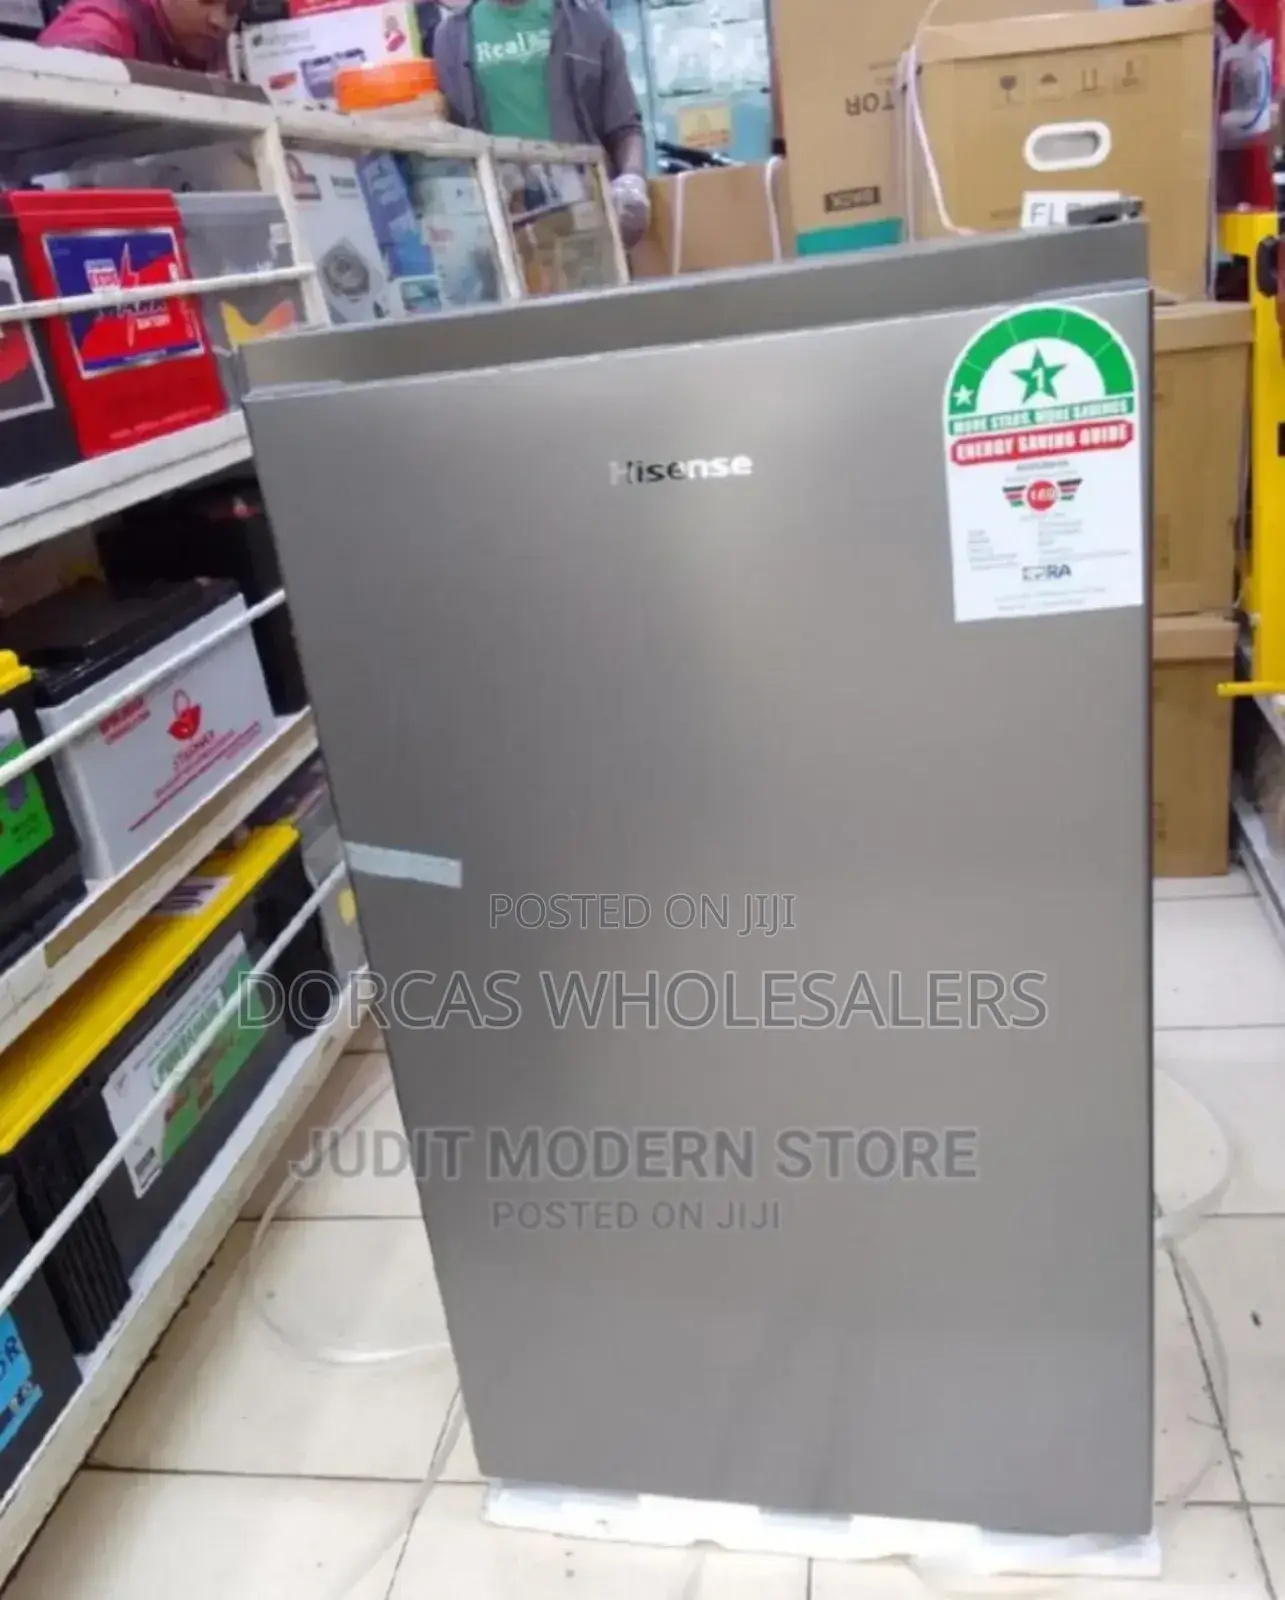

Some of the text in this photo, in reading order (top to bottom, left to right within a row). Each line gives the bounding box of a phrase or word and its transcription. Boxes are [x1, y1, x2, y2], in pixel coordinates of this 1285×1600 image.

[1031, 367, 1046, 391] 1
[955, 421, 1129, 462] ENERGY SAVING GUIDE
[608, 453, 755, 486] Hisense
